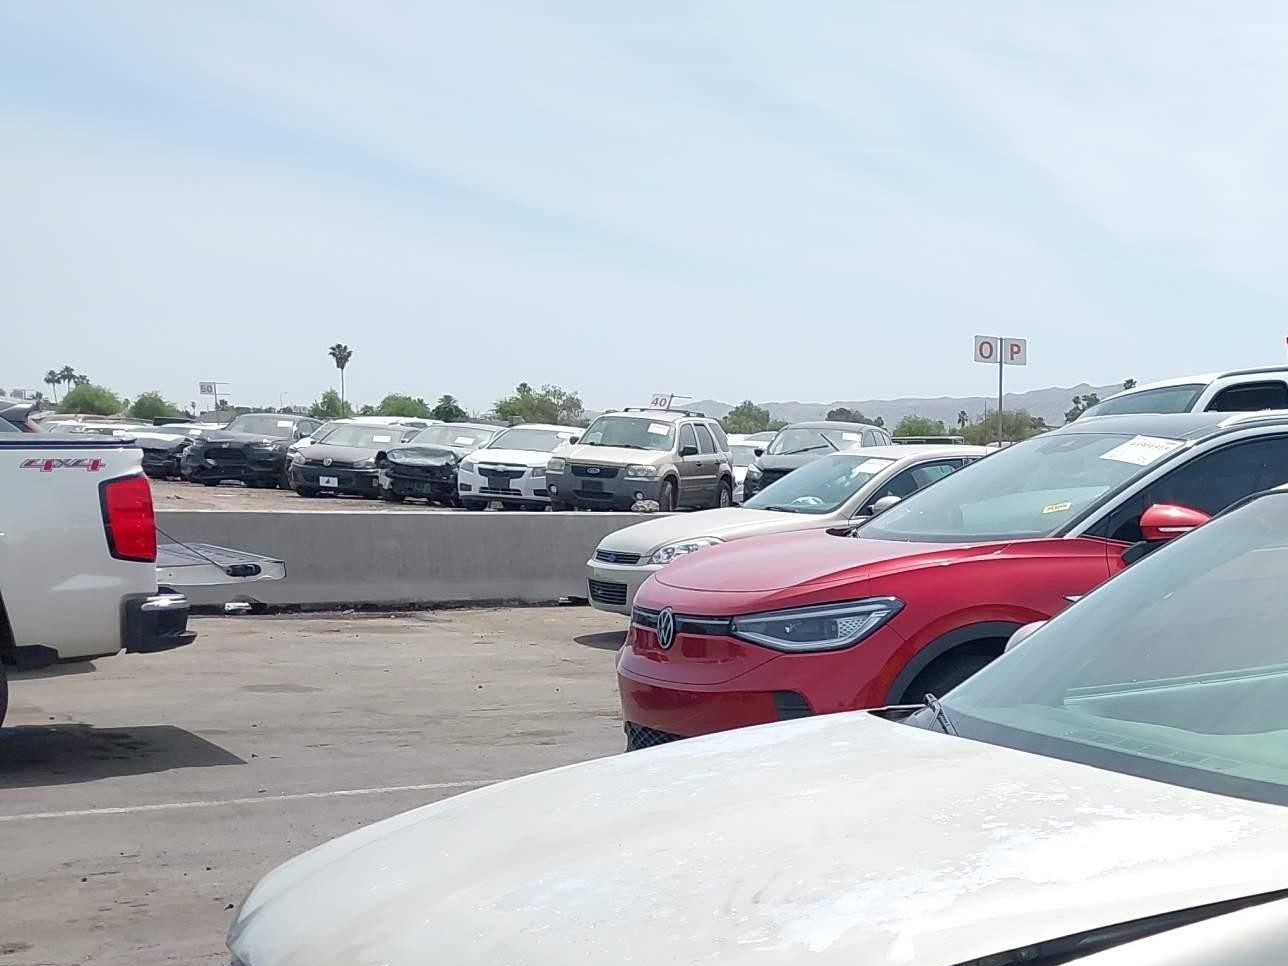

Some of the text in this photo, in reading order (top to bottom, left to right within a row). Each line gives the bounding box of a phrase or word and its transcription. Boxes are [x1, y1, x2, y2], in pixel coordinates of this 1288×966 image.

[979, 341, 993, 359] O
[1010, 343, 1021, 360] P
[651, 397, 667, 407] 40
